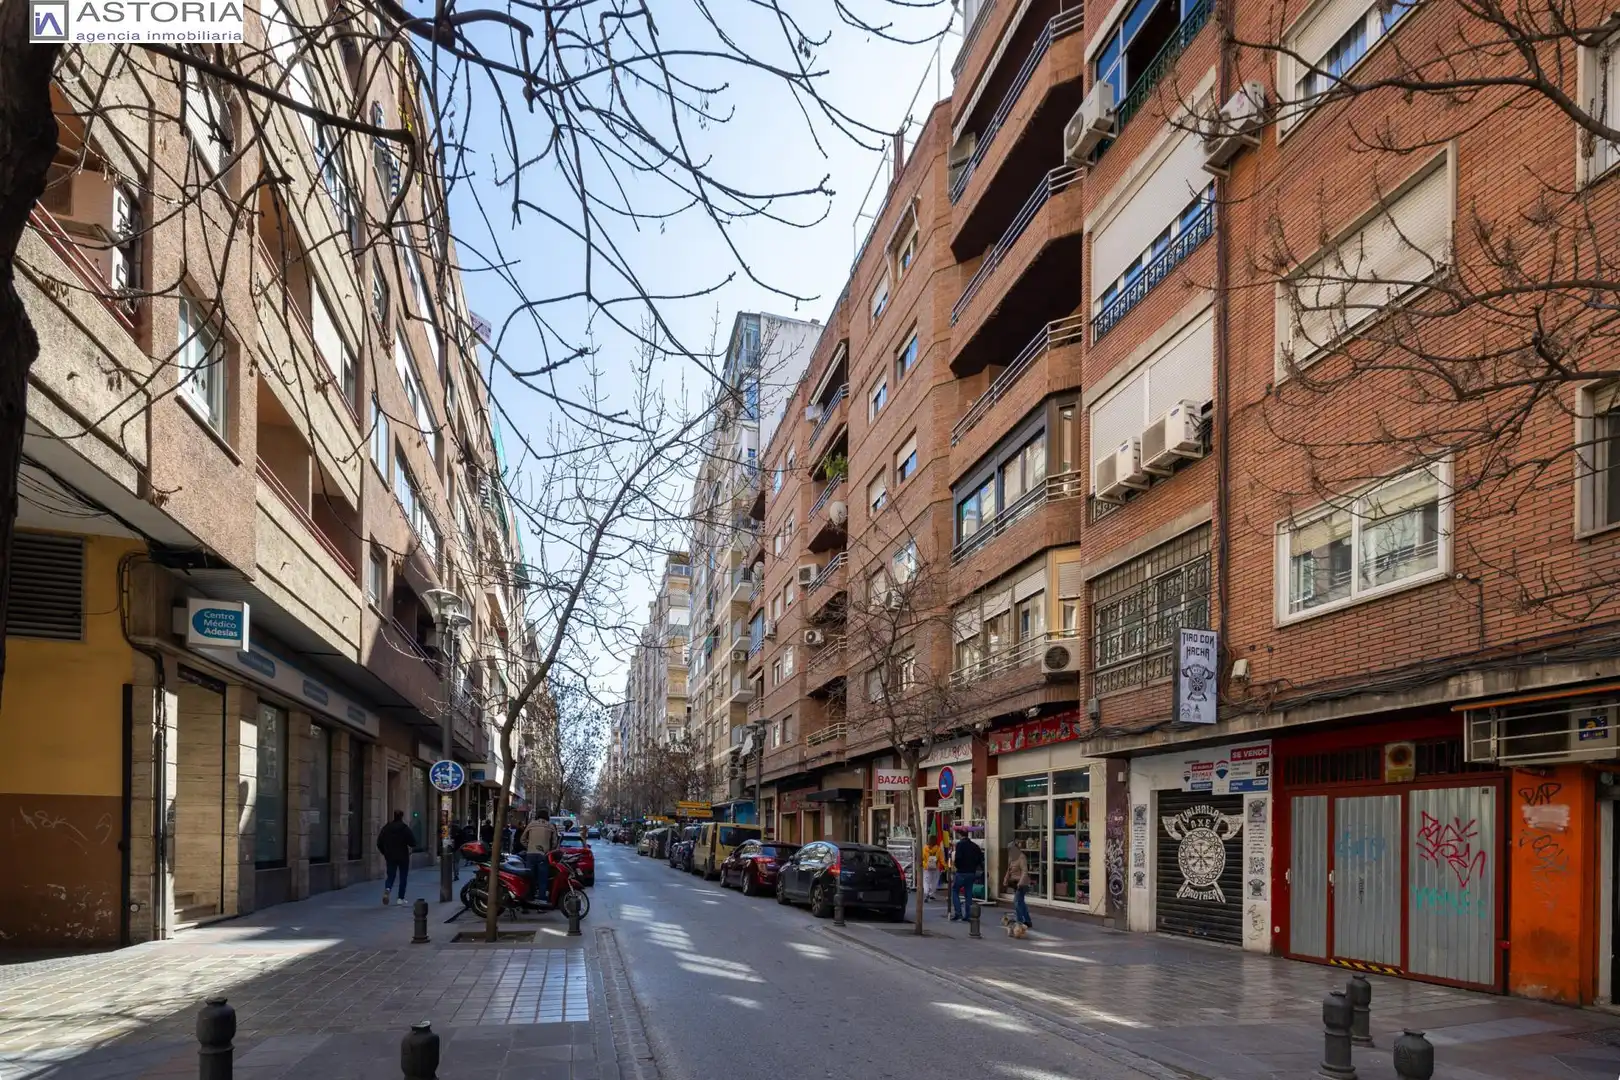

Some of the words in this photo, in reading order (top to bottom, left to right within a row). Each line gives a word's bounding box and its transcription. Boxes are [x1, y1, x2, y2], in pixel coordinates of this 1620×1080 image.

[204, 611, 235, 620] Centro
[204, 619, 237, 629] Médico
[204, 627, 238, 637] Adeslas
[1182, 632, 1198, 646] TIRO
[1200, 634, 1215, 648] CON
[1186, 646, 1210, 661] HACHA
[1232, 751, 1242, 759] SE
[1244, 748, 1268, 757] VENDE
[878, 775, 910, 785] BAZAR
[1181, 805, 1220, 823] VALHALLA
[1191, 819, 1211, 828] AXE
